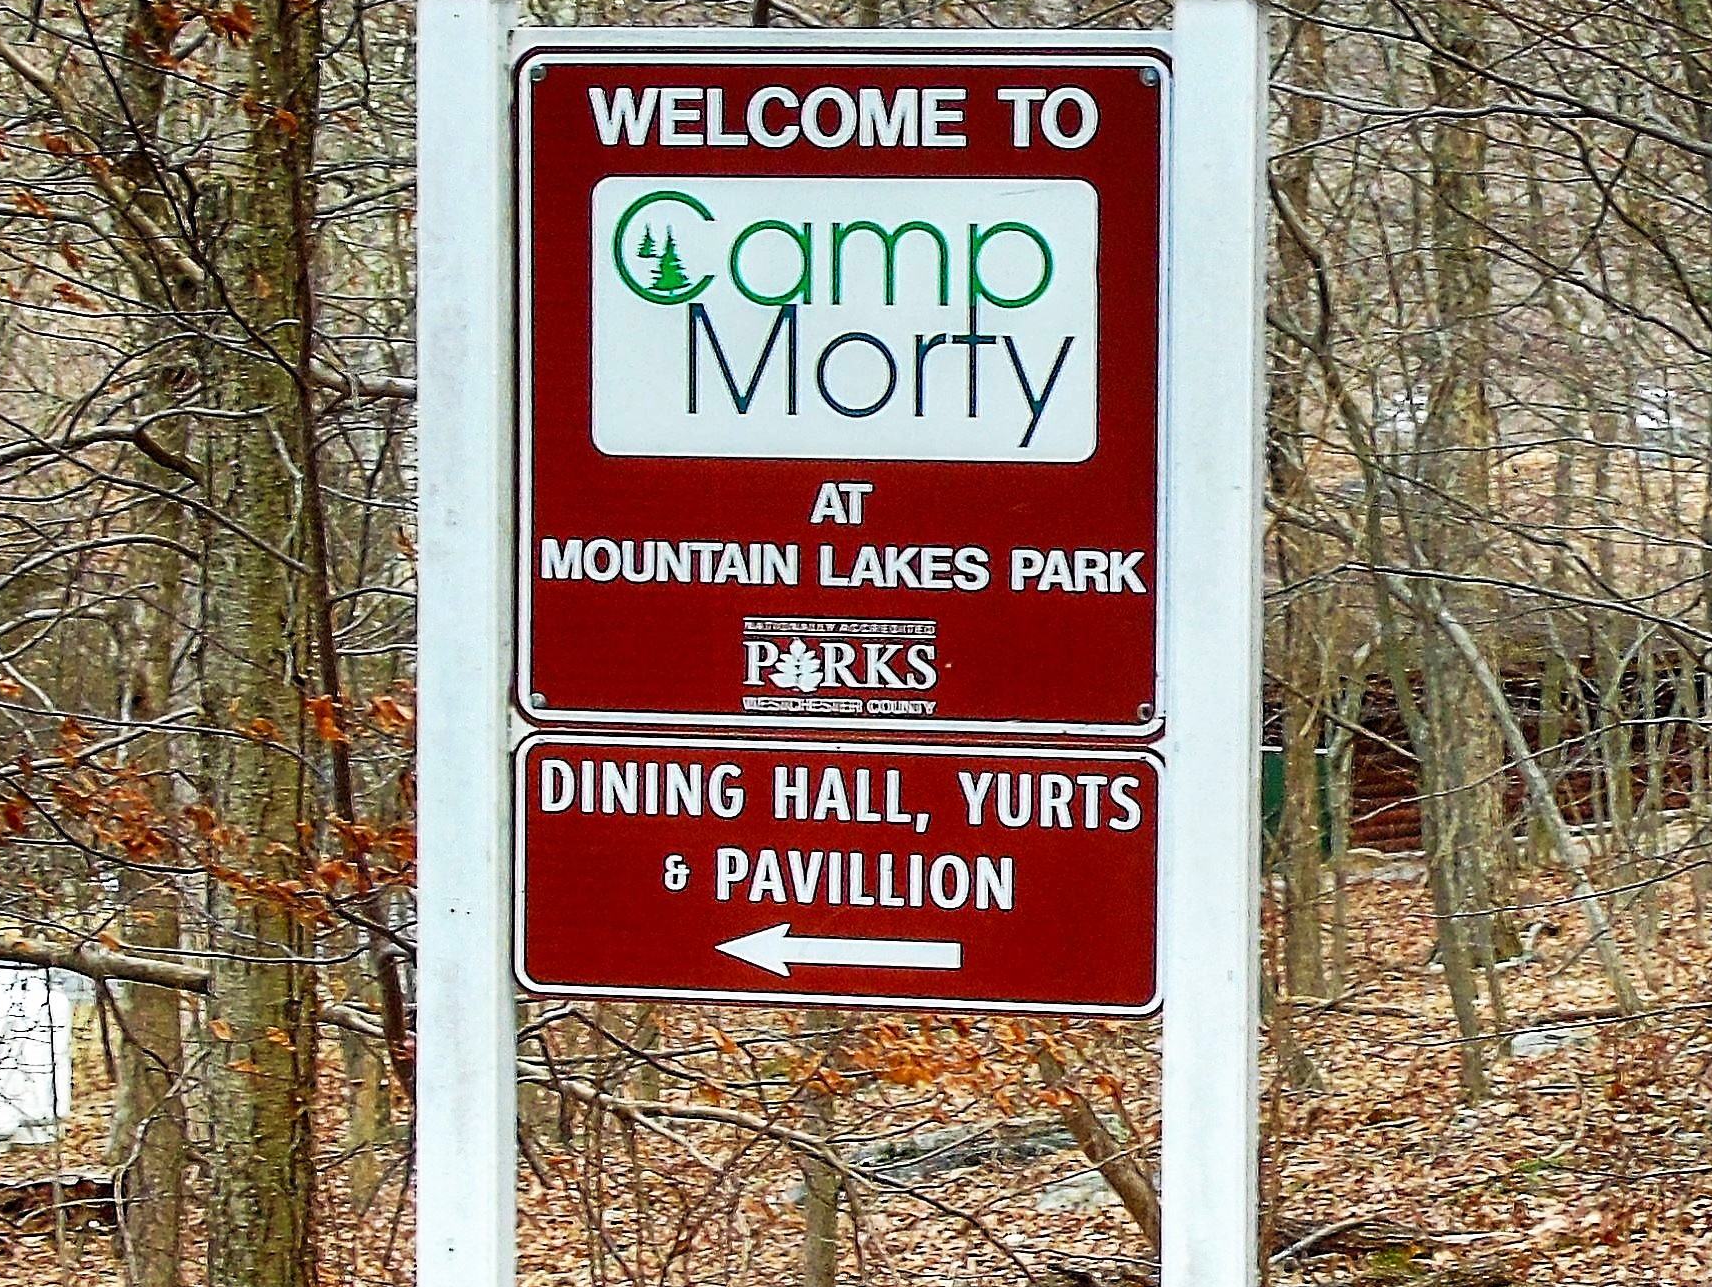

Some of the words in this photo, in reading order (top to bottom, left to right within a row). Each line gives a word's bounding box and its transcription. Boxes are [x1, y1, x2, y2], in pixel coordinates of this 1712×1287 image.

[588, 86, 967, 148] WELCOME
[997, 87, 1099, 149] TO
[613, 190, 1052, 308] Camp
[687, 303, 1075, 448] Morty
[810, 482, 874, 524] AT
[541, 538, 800, 585] MOUNTAIN
[819, 544, 990, 590] LAKES
[1011, 549, 1146, 593] PARK
[867, 700, 936, 714] COUNTY
[540, 759, 745, 818] DINING
[773, 766, 932, 833] HALL,
[959, 771, 1143, 832] YURTS
[663, 854, 690, 891] &
[715, 847, 1015, 911] PAVILLION
